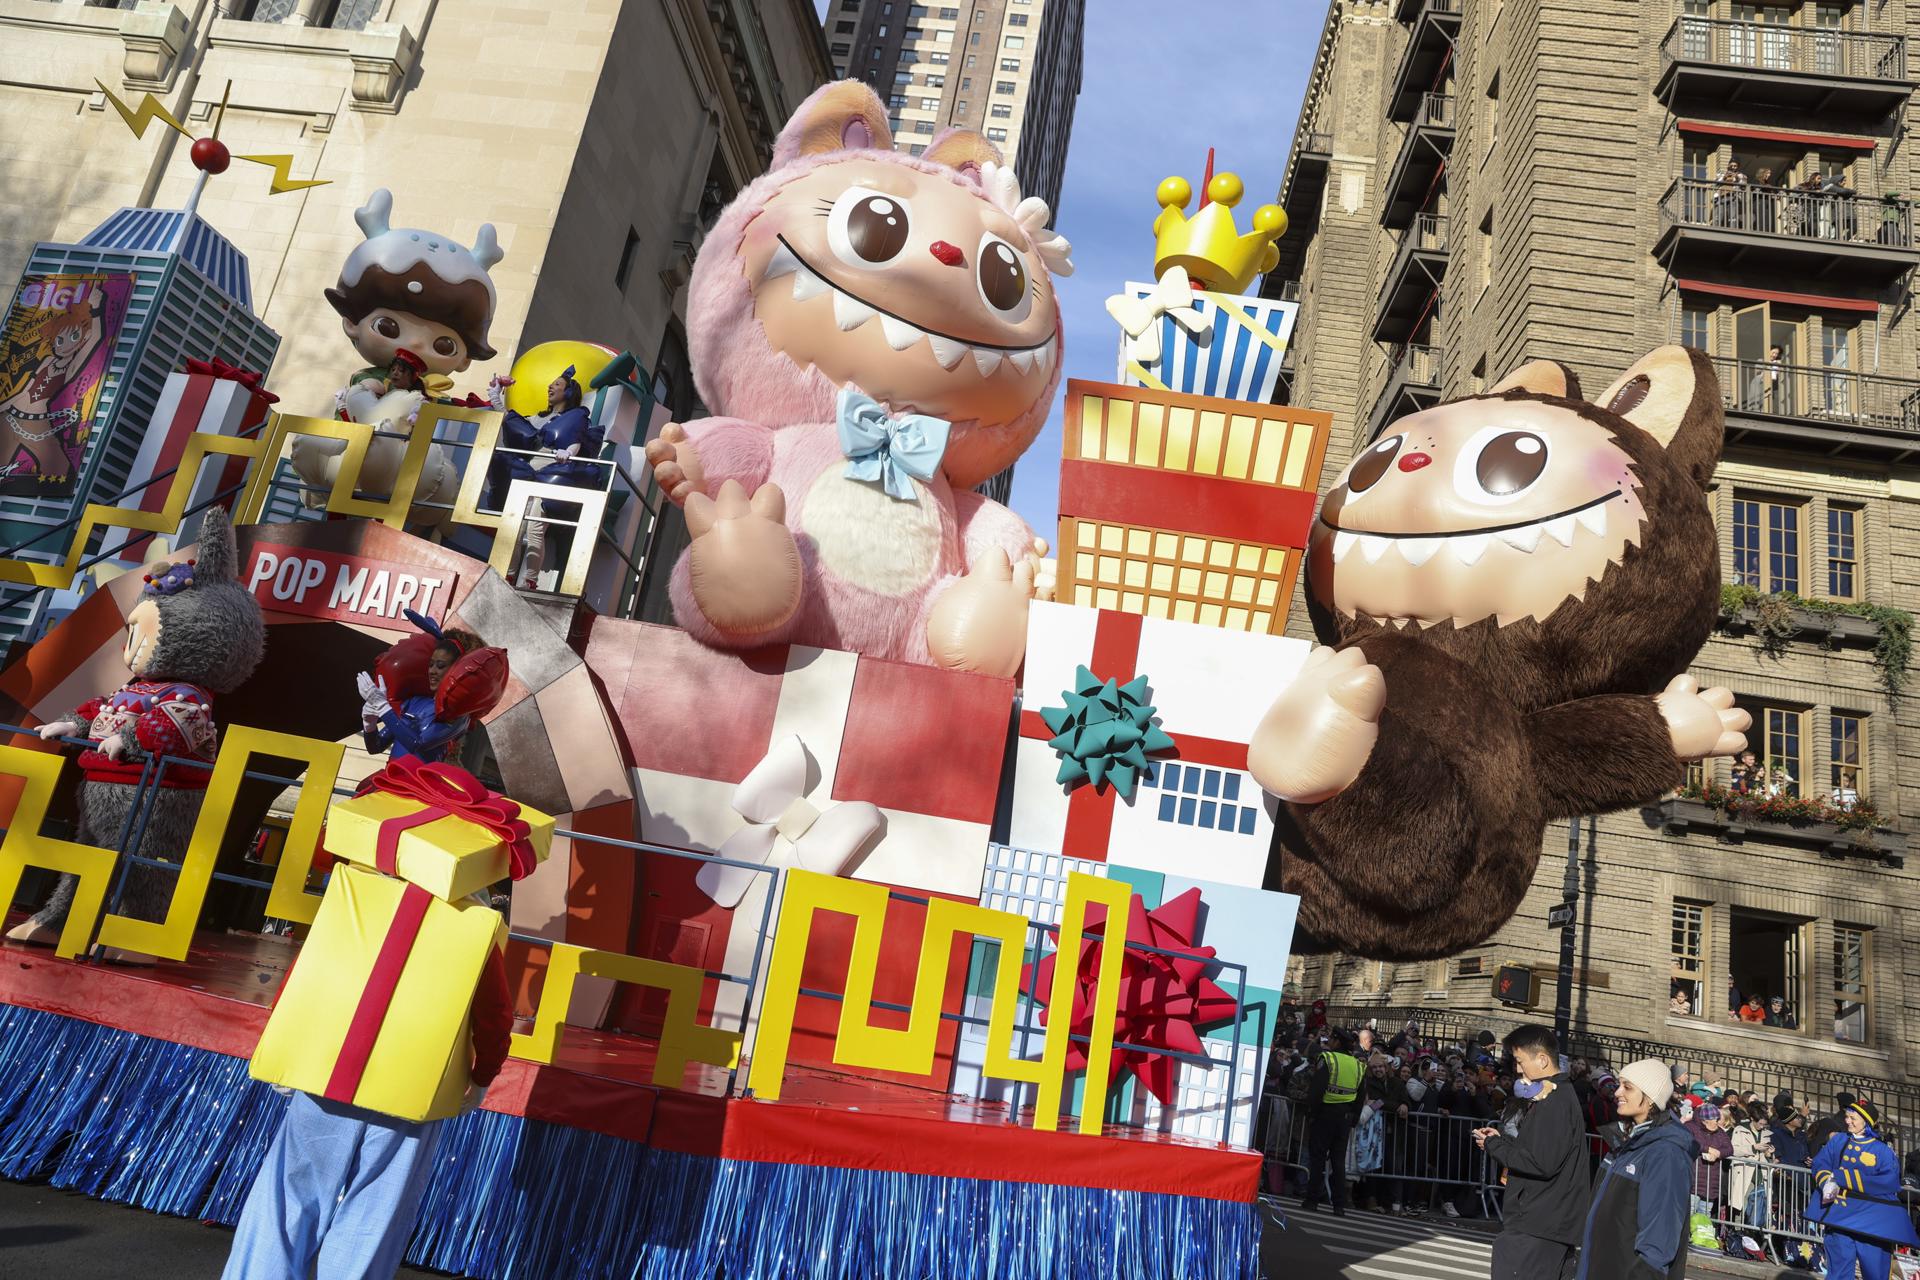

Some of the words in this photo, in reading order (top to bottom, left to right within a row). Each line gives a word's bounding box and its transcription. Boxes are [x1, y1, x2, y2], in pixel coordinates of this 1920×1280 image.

[20, 283, 86, 310] GIGI
[248, 551, 327, 604] POP
[328, 564, 443, 621] MART
